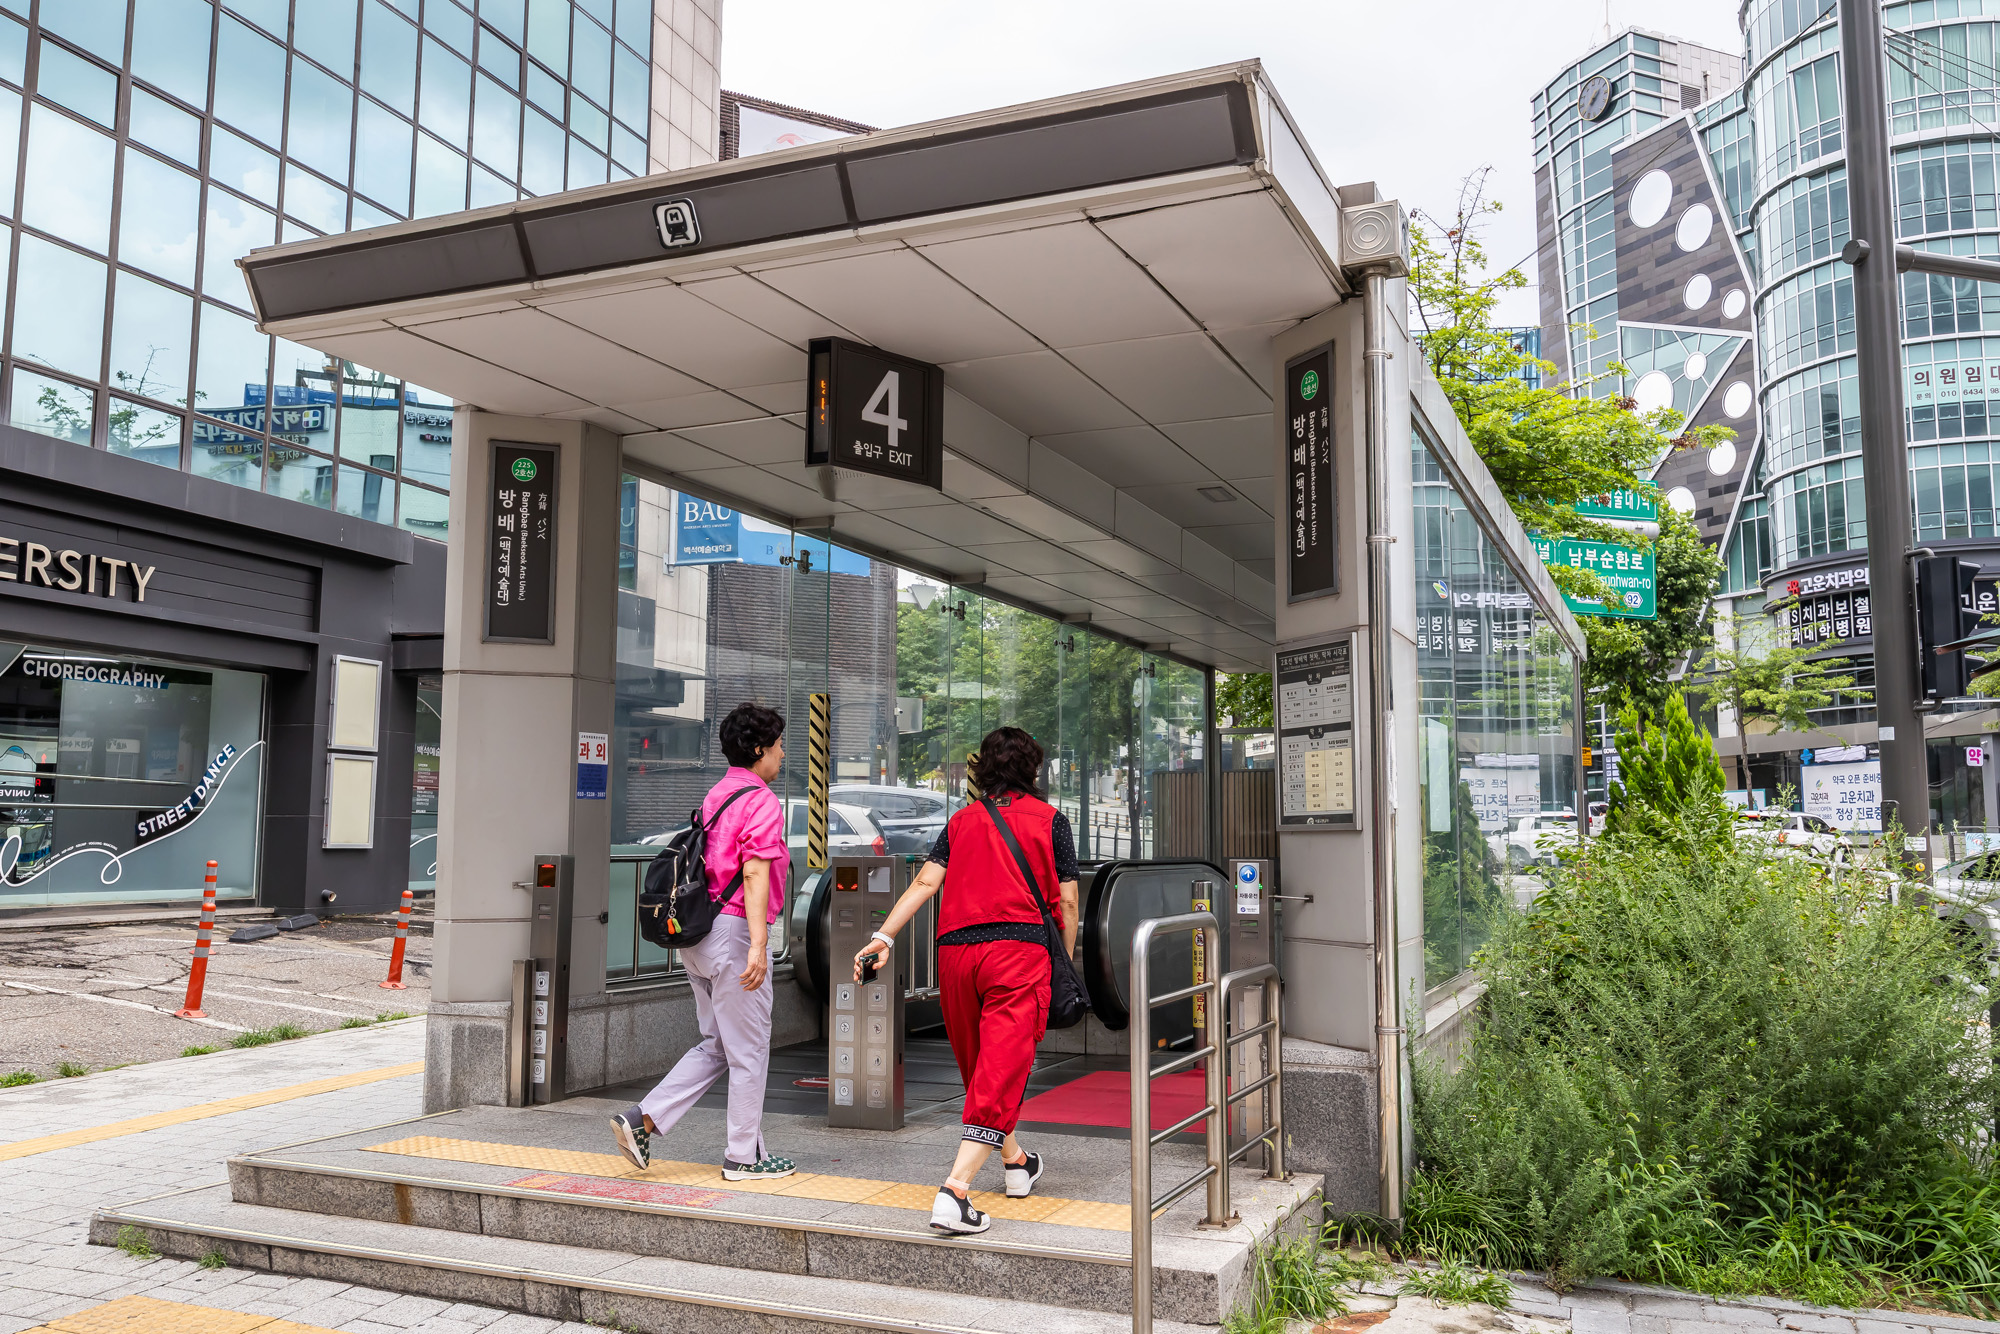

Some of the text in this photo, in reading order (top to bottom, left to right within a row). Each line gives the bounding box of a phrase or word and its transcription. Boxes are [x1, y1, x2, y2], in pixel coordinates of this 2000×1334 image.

[1304, 374, 1315, 385] 225
[1303, 383, 1317, 396] 2호선
[1963, 388, 1983, 396] 6434
[861, 370, 908, 447] 4
[853, 440, 913, 467] 출입구 EXIT
[514, 469, 534, 477] 2호선
[684, 501, 731, 522] BAU
[518, 491, 531, 601] Bangbae (Baekseok Arts Univ.)
[683, 544, 732, 554] 백석예술대학교
[1568, 547, 1645, 571] 남부순환로
[0, 537, 156, 602] ERSITY
[1627, 594, 1639, 605] 92
[23, 660, 165, 689] CHOREOGRAPHY
[1968, 749, 1981, 764] 약
[1833, 775, 1845, 785] 약국
[1848, 774, 1860, 784] 오픈
[138, 743, 235, 837] STREET DANCE
[1840, 790, 1874, 804] 고운치과
[1836, 807, 1853, 821] 정상
